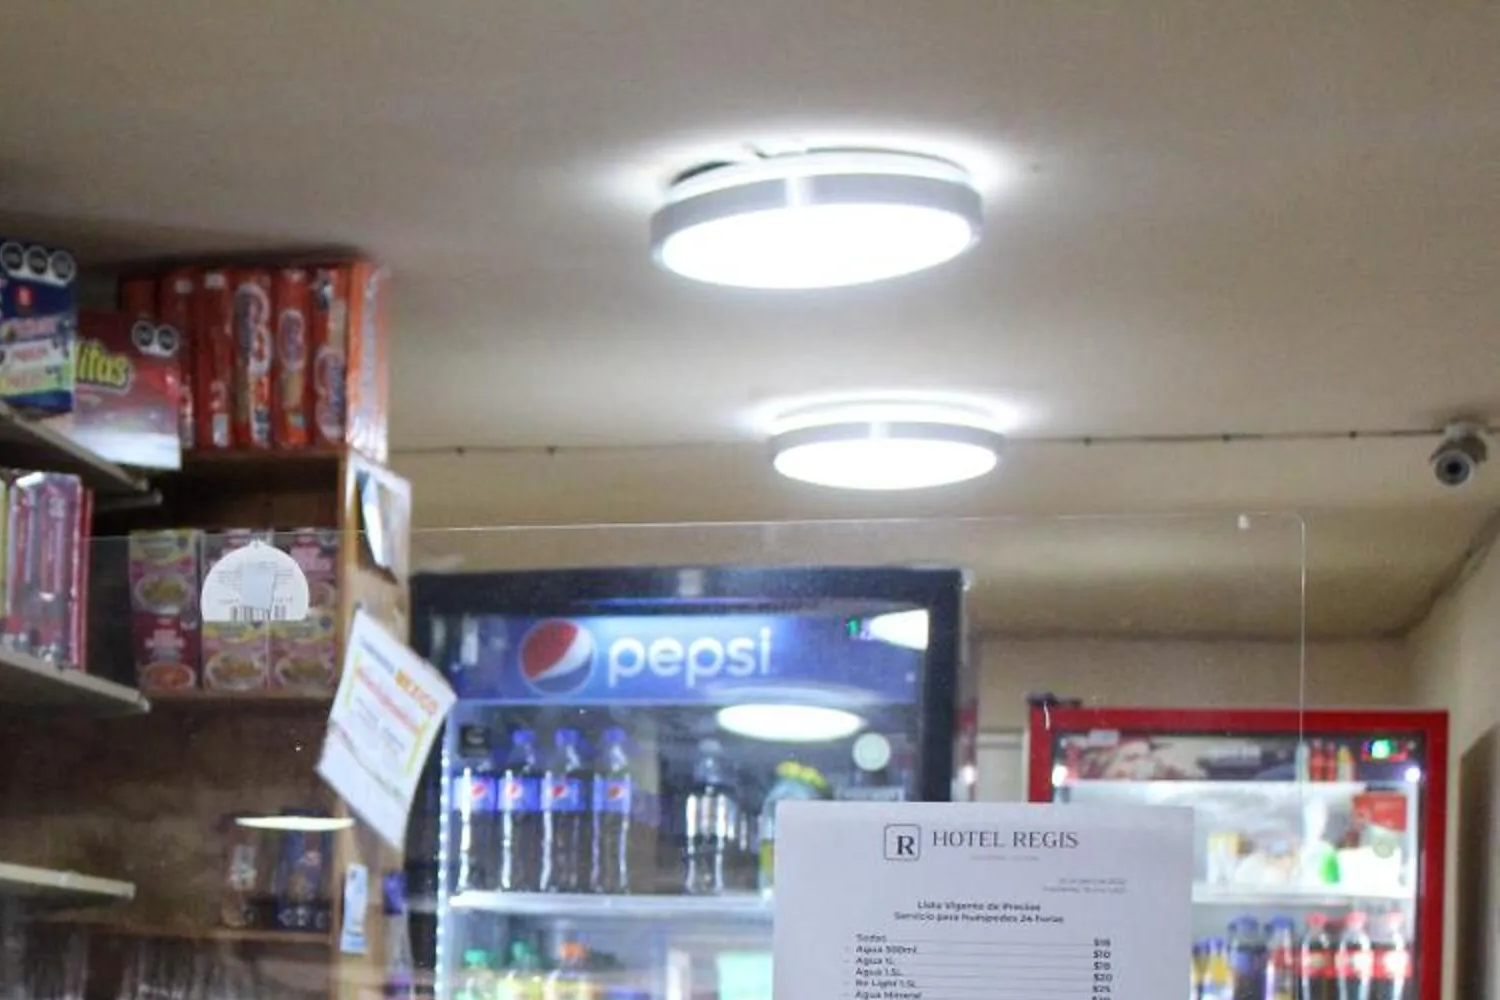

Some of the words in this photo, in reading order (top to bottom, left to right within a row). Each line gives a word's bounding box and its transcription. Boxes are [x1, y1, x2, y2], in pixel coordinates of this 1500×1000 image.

[608, 627, 771, 689] pepsi
[897, 834, 915, 856] R
[932, 830, 1005, 849] HOTEL
[1013, 831, 1080, 849] REGIS
[855, 956, 882, 967] Agua
[855, 967, 882, 977] Agua
